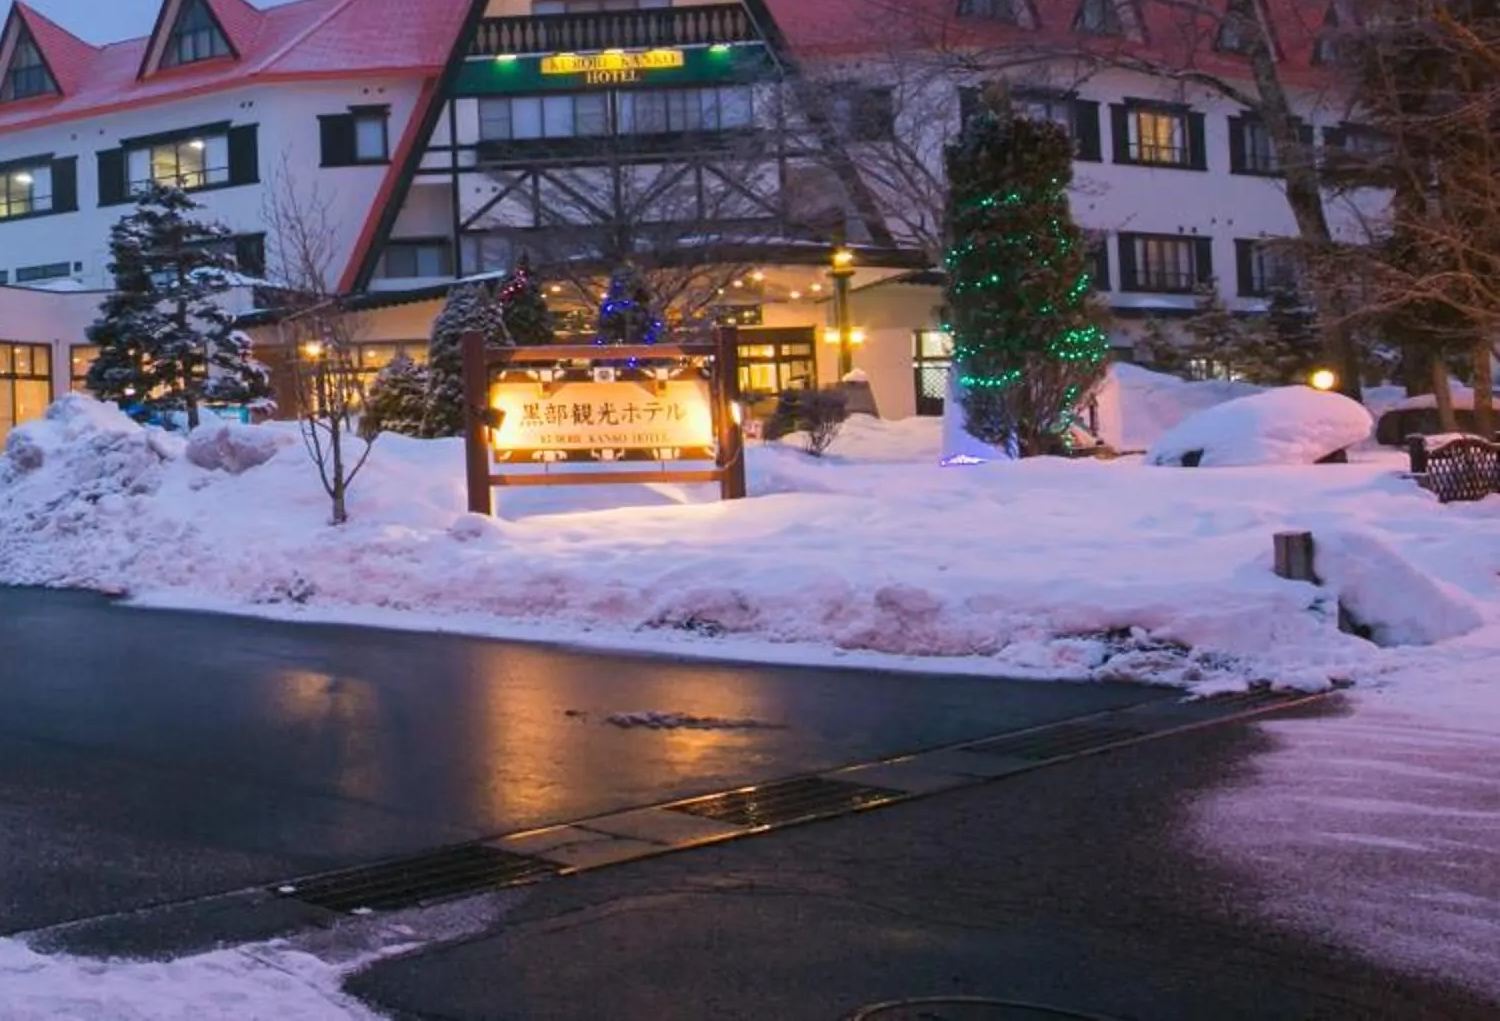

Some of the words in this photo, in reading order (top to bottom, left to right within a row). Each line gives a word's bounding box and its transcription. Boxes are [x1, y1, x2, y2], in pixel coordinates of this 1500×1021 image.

[586, 69, 641, 84] HOTEL
[520, 402, 687, 428] 黒部観光ホテル
